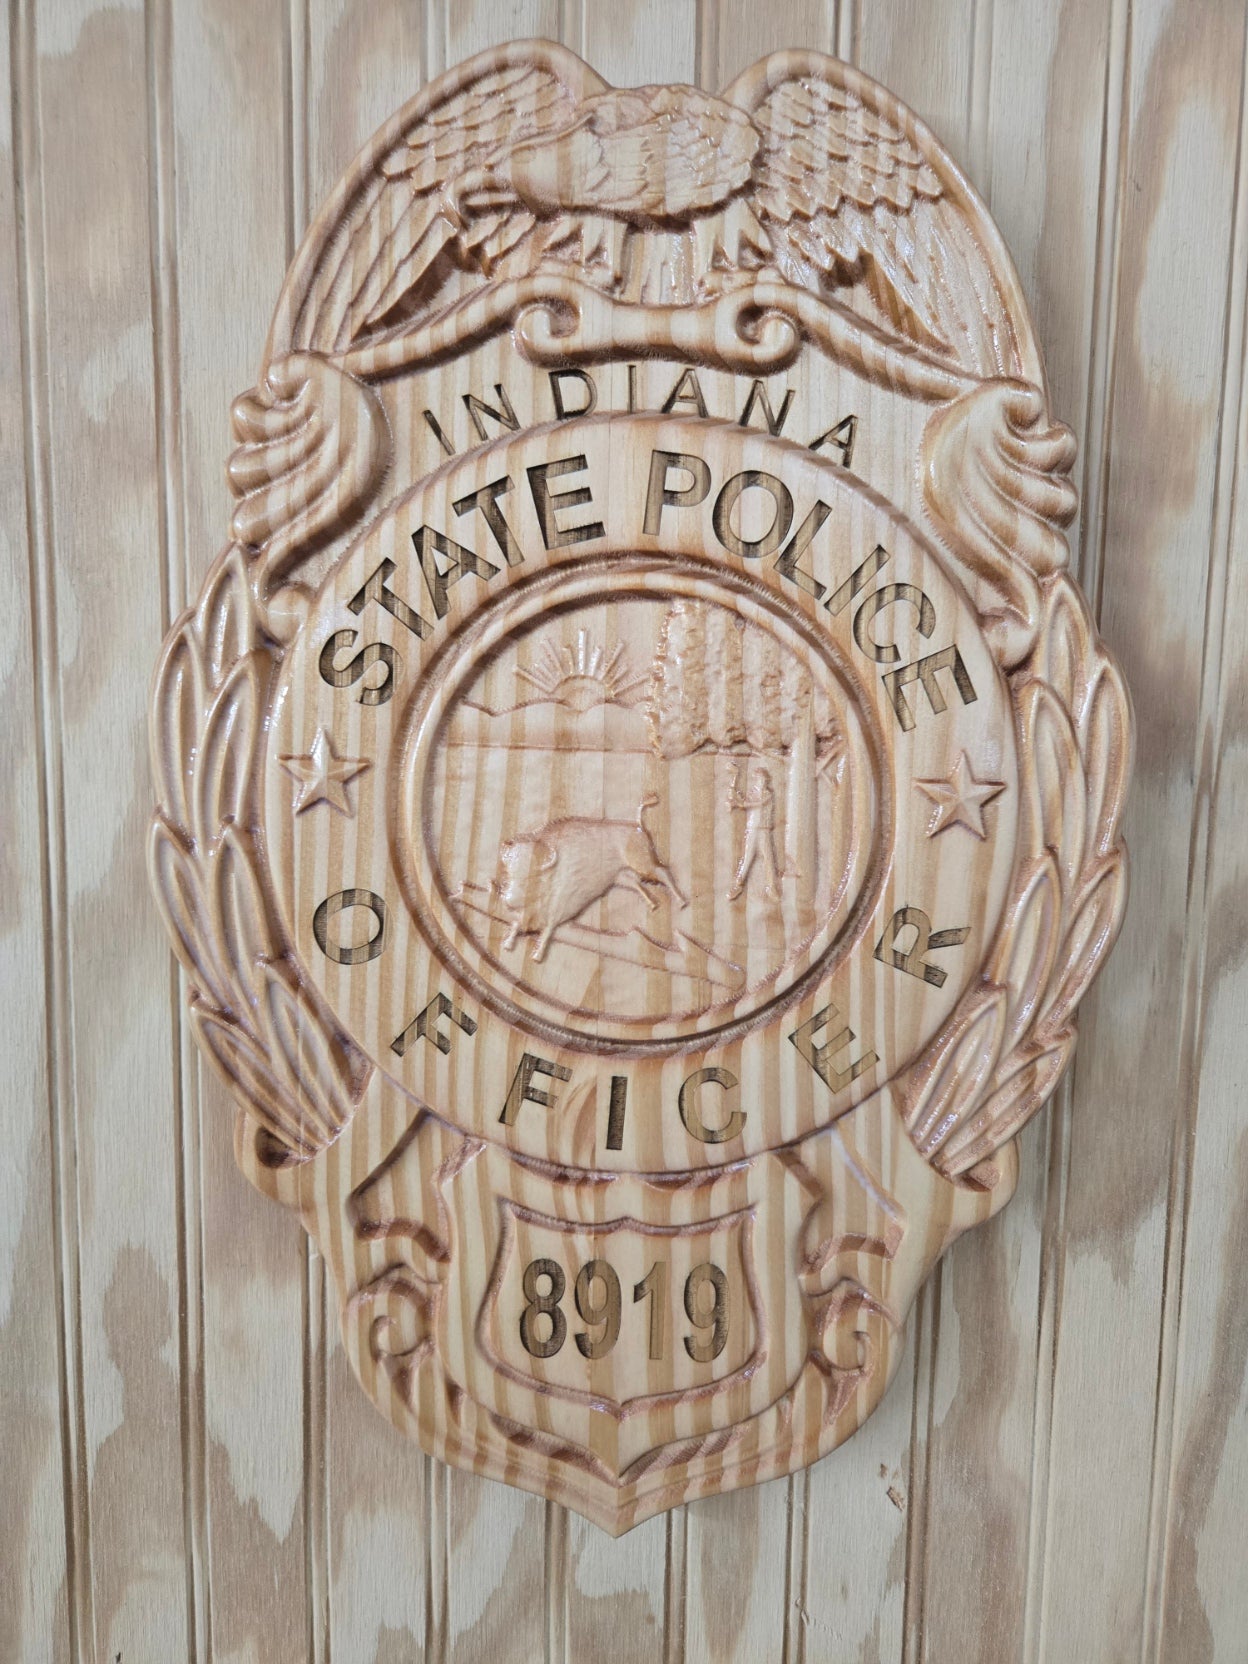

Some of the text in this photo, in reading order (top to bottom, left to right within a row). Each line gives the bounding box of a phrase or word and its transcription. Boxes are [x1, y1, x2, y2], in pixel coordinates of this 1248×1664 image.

[422, 364, 858, 467] INDIANA
[318, 449, 977, 732] STATE POLICE
[313, 889, 971, 1151] OFFICER
[520, 1258, 729, 1360] 8919
